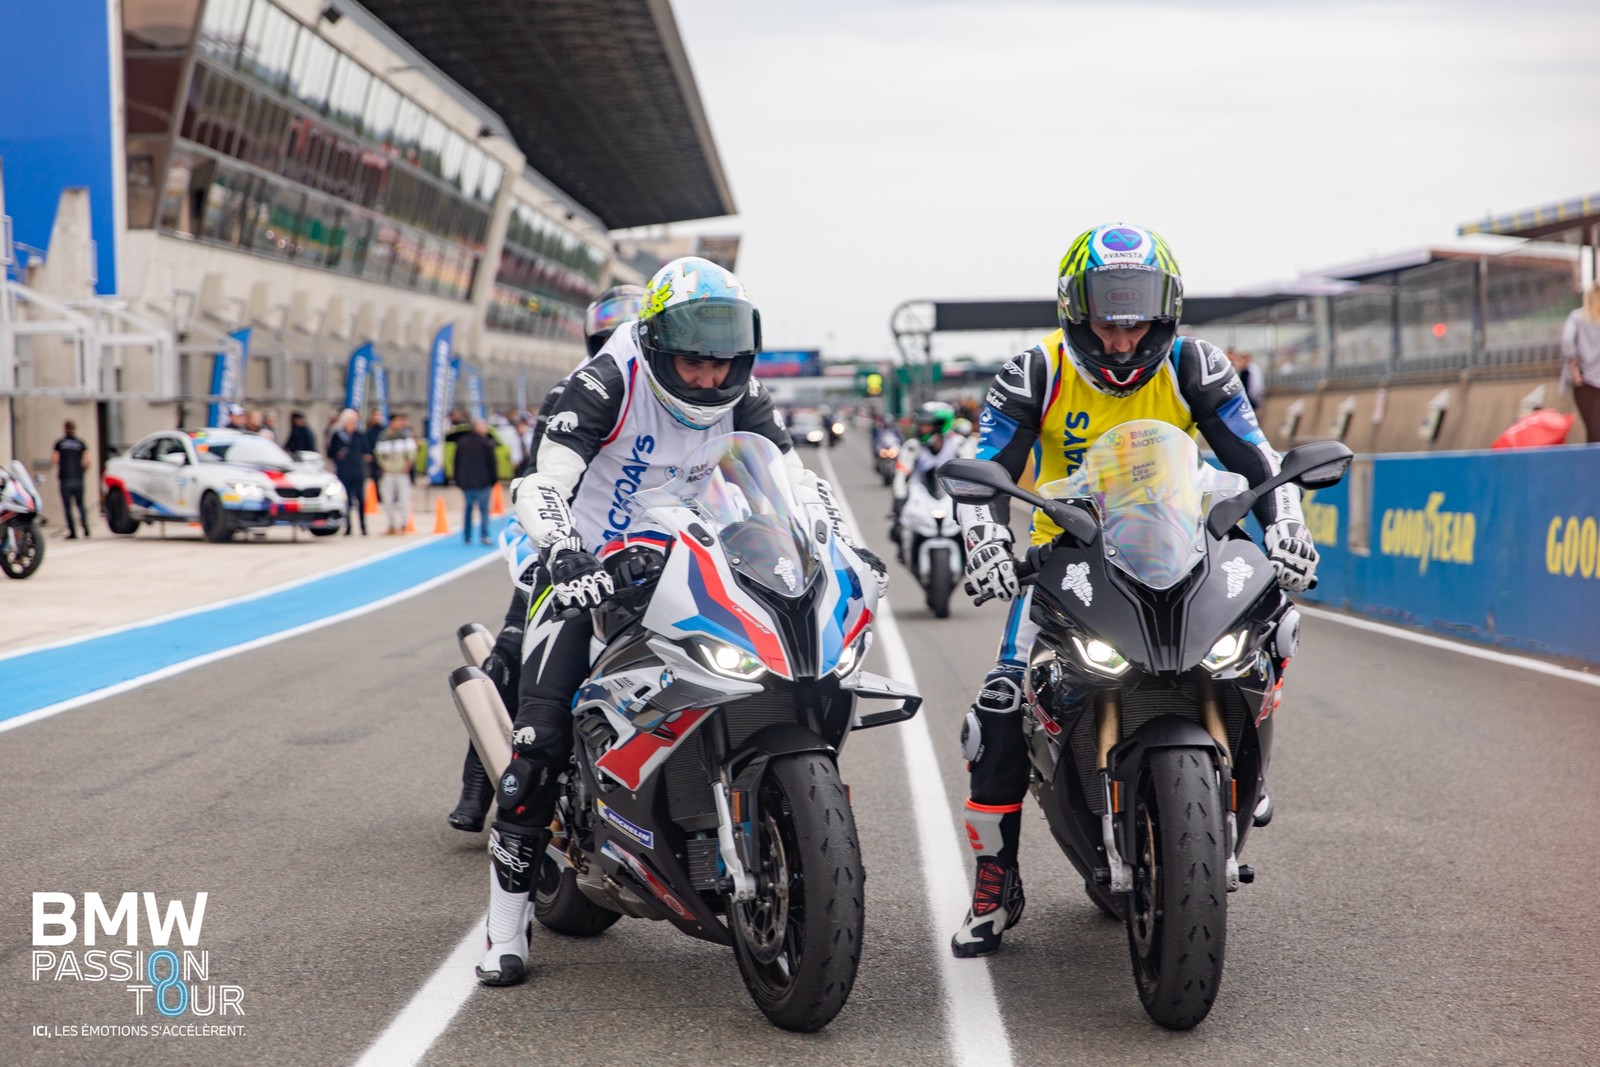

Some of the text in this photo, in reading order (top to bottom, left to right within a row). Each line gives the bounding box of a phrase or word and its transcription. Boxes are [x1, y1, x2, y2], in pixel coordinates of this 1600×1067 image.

[594, 434, 655, 556] ACKDAYS
[1380, 501, 1476, 567] GOODYEAR
[608, 812, 651, 843] MICHELIN
